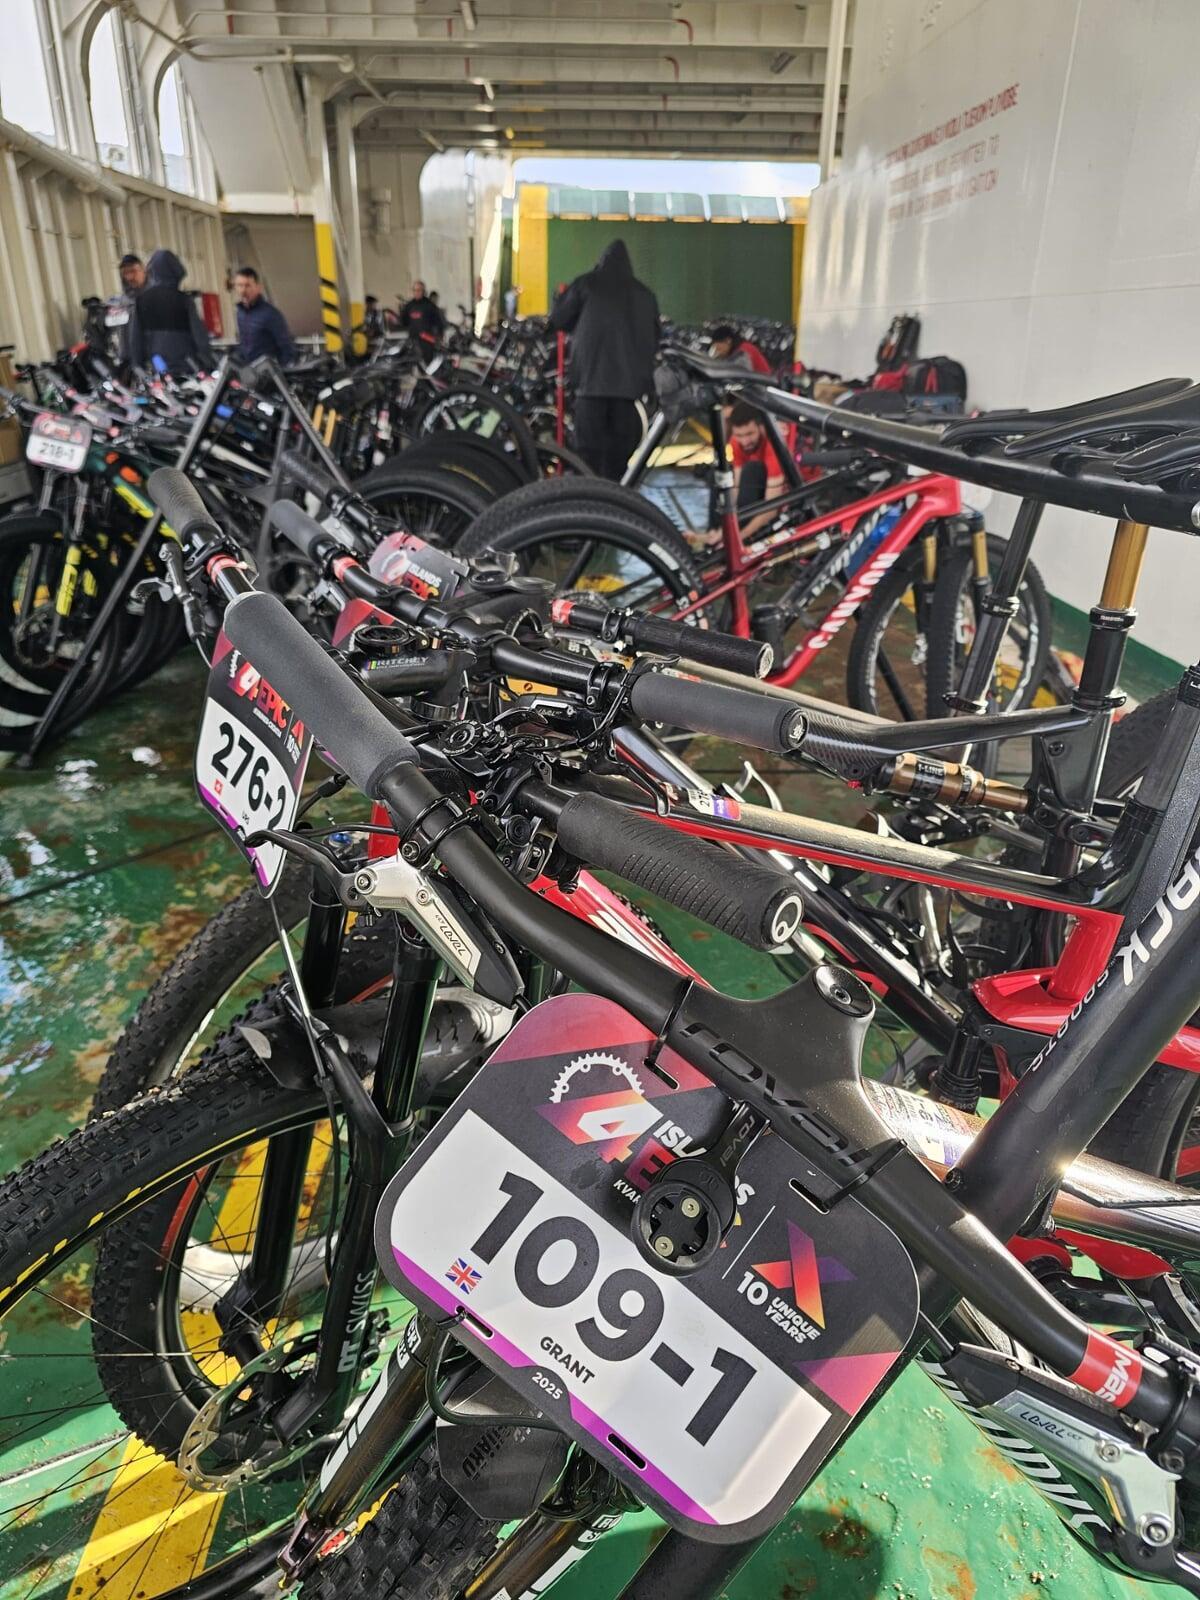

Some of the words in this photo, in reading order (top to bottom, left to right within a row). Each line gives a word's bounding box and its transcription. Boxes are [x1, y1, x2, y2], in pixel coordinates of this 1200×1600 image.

[377, 656, 428, 666] RITCHEY
[211, 722, 286, 831] 276-2
[1115, 848, 1200, 986] ACK
[346, 1269, 378, 1334] SWISS
[470, 1171, 757, 1447] 109-1
[737, 1270, 769, 1306] 10
[765, 1304, 807, 1344] YEARS
[771, 1296, 821, 1341] UNIQUE
[337, 1341, 361, 1373] DT
[540, 1336, 595, 1384] GRANT
[531, 1371, 563, 1400] 2025
[1020, 1411, 1065, 1440] LEVEL
